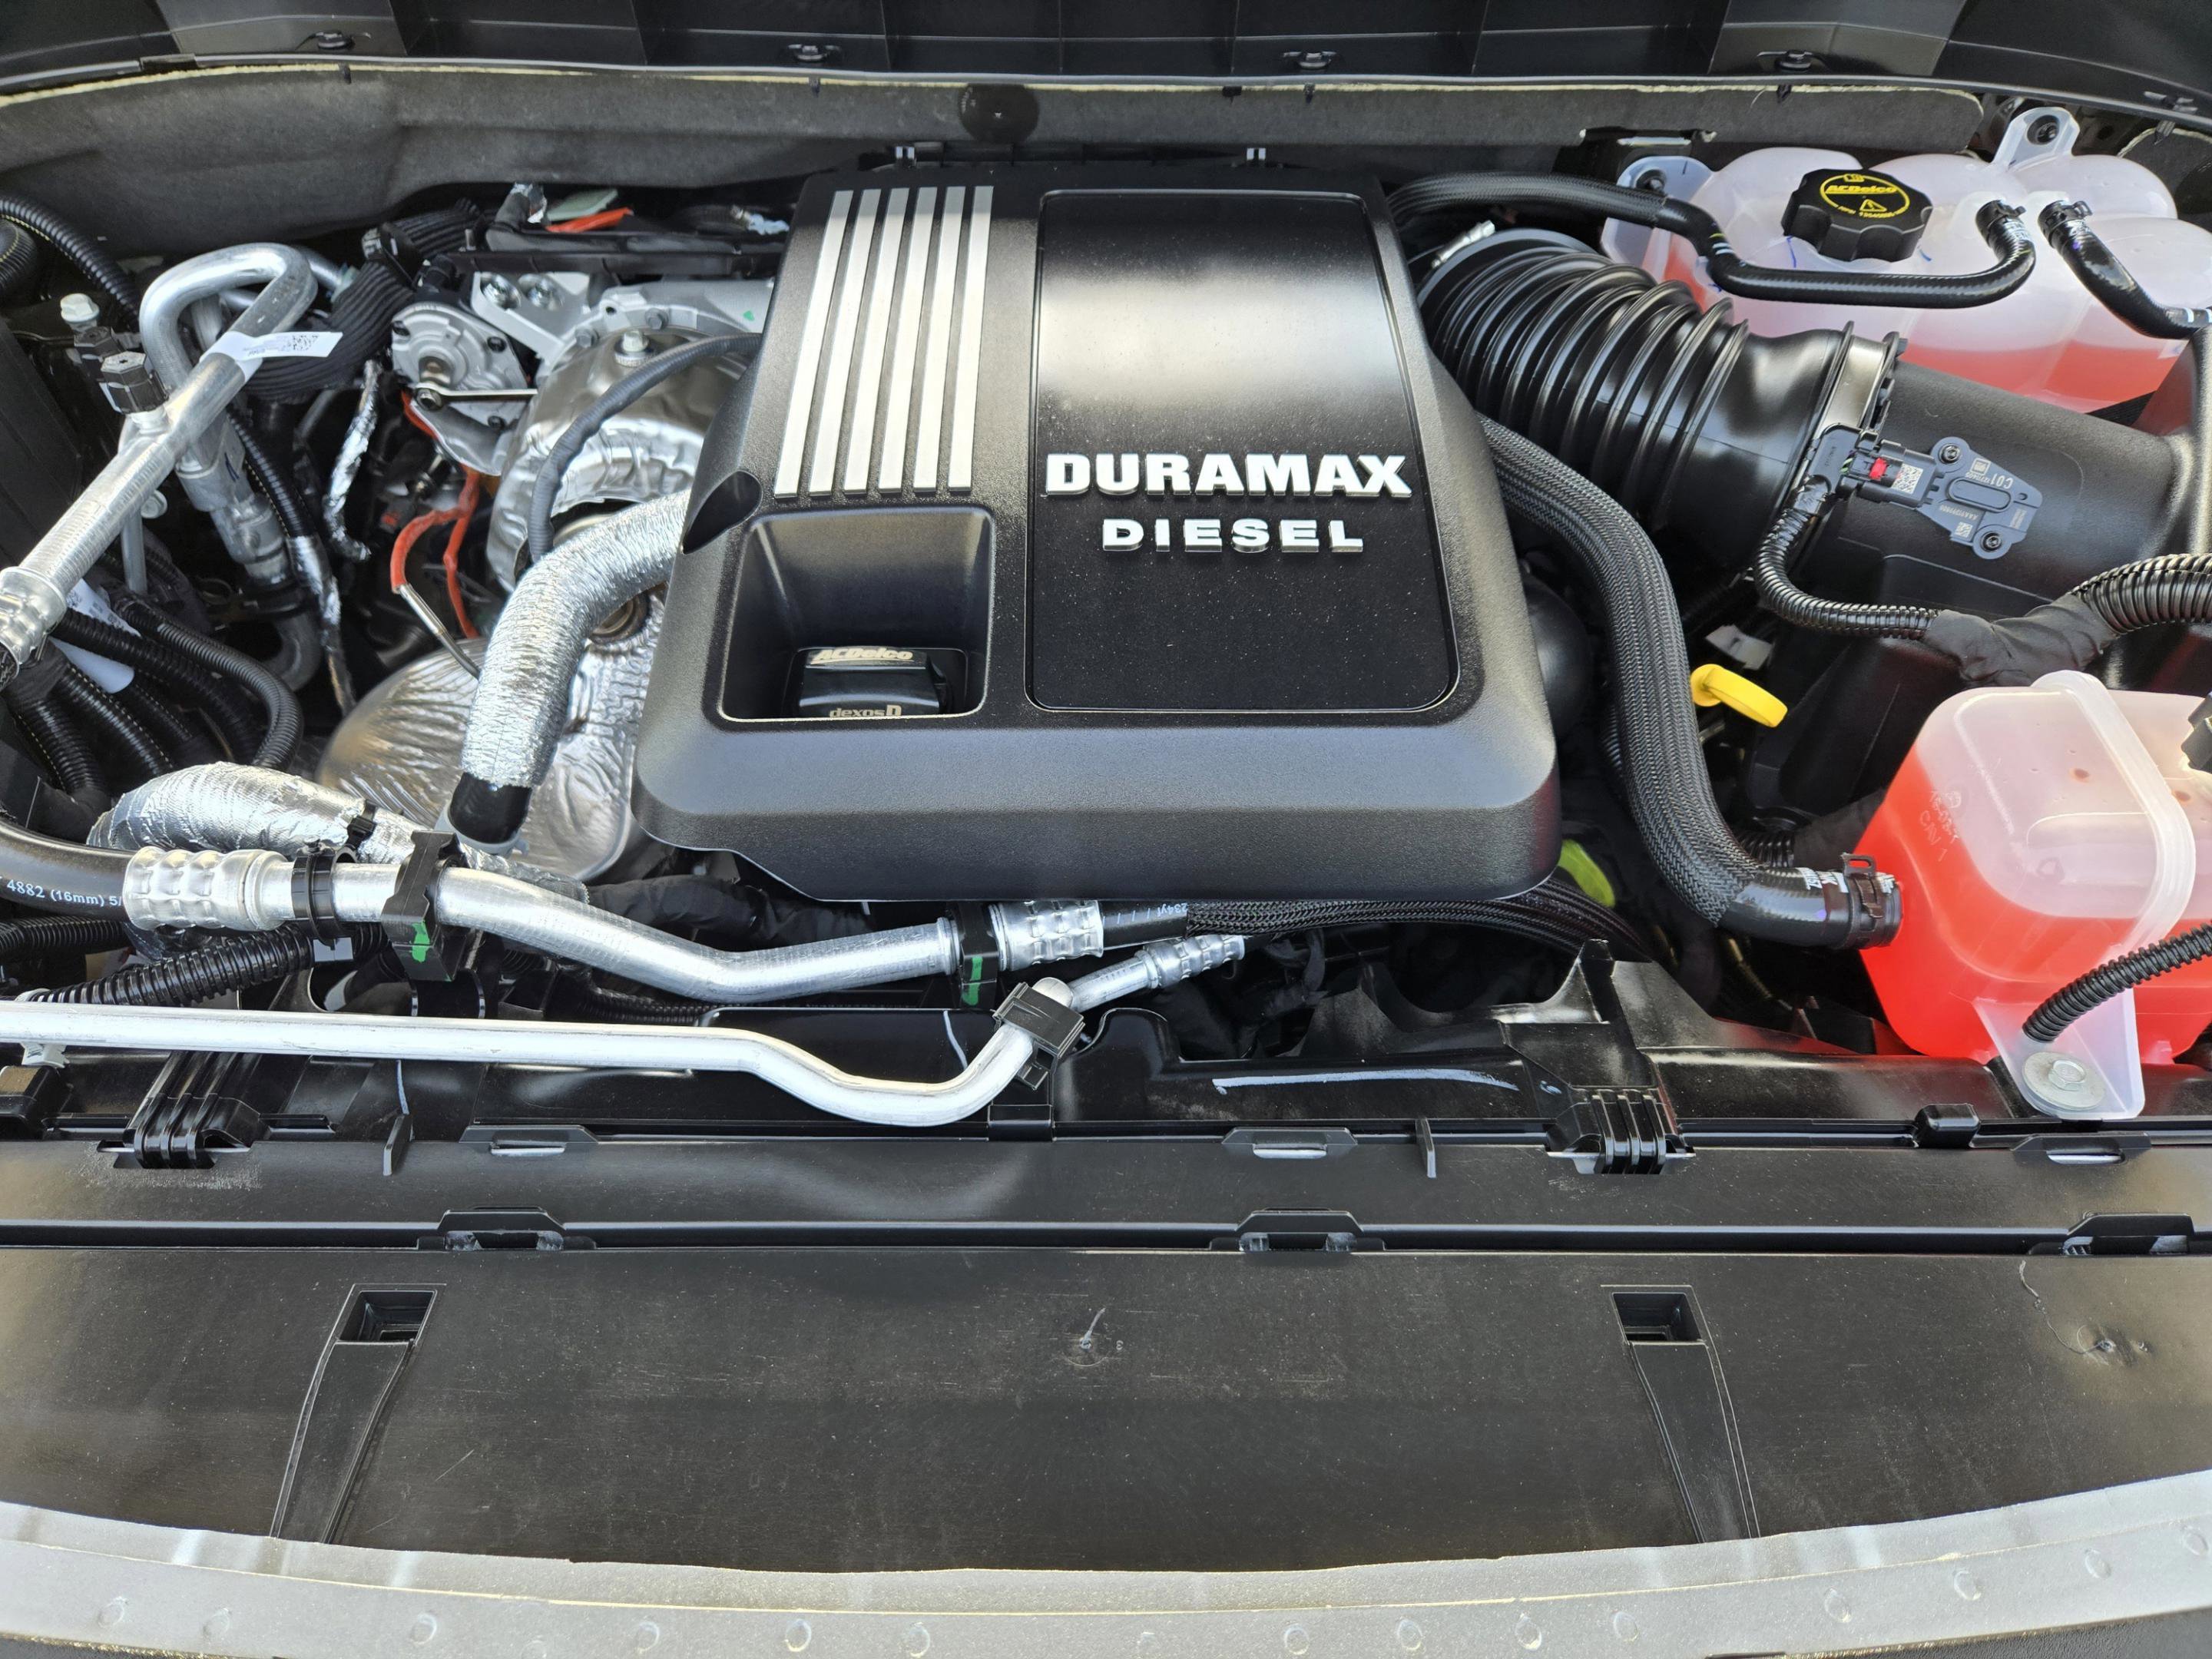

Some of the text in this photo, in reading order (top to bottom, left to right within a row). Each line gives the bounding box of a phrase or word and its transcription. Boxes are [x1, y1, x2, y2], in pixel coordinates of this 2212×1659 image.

[1046, 453, 1412, 498] DURAMAX
[1103, 518, 1363, 552] DIESEL
[812, 647, 914, 664] ACDelco
[6, 879, 45, 899] 4882
[50, 889, 104, 907] (16mm)
